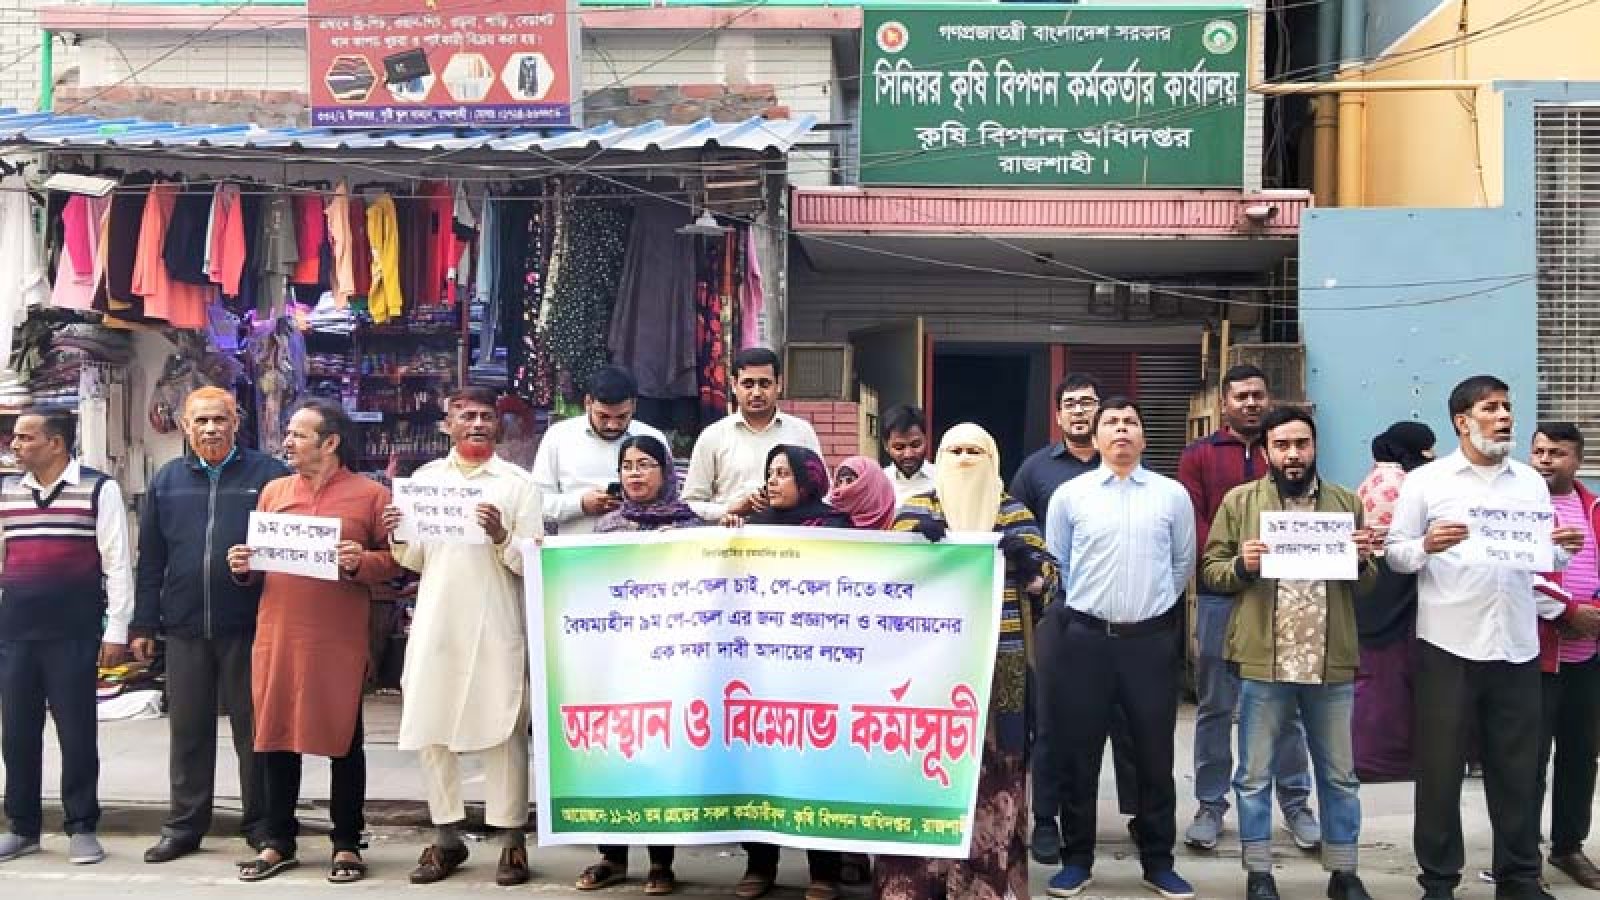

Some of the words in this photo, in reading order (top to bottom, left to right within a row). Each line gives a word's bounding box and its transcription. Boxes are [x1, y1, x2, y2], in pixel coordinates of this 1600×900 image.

[938, 20, 1025, 41] গণপ্রজাতন্ত্রী
[1031, 25, 1109, 43] বাংলাদেশ
[1114, 25, 1171, 41] সরকার
[872, 57, 945, 107] সিনিয়র
[948, 57, 990, 113] কৃষি
[994, 57, 1061, 108] বিপণন
[1065, 57, 1158, 108] কর্মকর্তার
[1161, 57, 1241, 108] কার্যালয়
[914, 120, 970, 151] কৃষি
[977, 120, 1069, 149] বিপণন
[1073, 121, 1195, 150] অধিদপ্তর
[282, 523, 337, 539] পে-স্কেল
[607, 579, 667, 600] অবিলম্বে
[671, 577, 729, 597] পে-স্কেল
[733, 574, 767, 598] চাই,
[770, 579, 832, 598] পে-স্কেল
[837, 576, 878, 597] দিতে
[881, 582, 915, 600] হবে
[563, 610, 635, 634] বৈষম্যহীন
[639, 613, 662, 631] ৯ম
[665, 609, 724, 629] পে-স্কেল
[727, 609, 753, 626] এর
[756, 610, 785, 627] জন্য
[789, 611, 851, 631] প্রজ্ঞাপন
[857, 614, 871, 631] ও
[875, 614, 963, 633] বাস্তবায়নের
[650, 645, 675, 660] এক
[680, 641, 711, 659] দফা
[716, 635, 751, 660] দাবী
[754, 643, 814, 661] আদায়ের
[819, 645, 865, 665] লক্ষ্যে
[559, 699, 673, 760] অবস্থান
[684, 698, 713, 750] ও
[721, 678, 839, 751] বিক্ষোভ
[849, 677, 981, 789] কর্মসূচী
[610, 808, 641, 825] ১১-২০
[643, 807, 662, 823] তম
[663, 807, 700, 824] গ্রেডের
[703, 806, 730, 822] সকল
[794, 806, 816, 832] কৃষি
[818, 807, 857, 832] বিপণন
